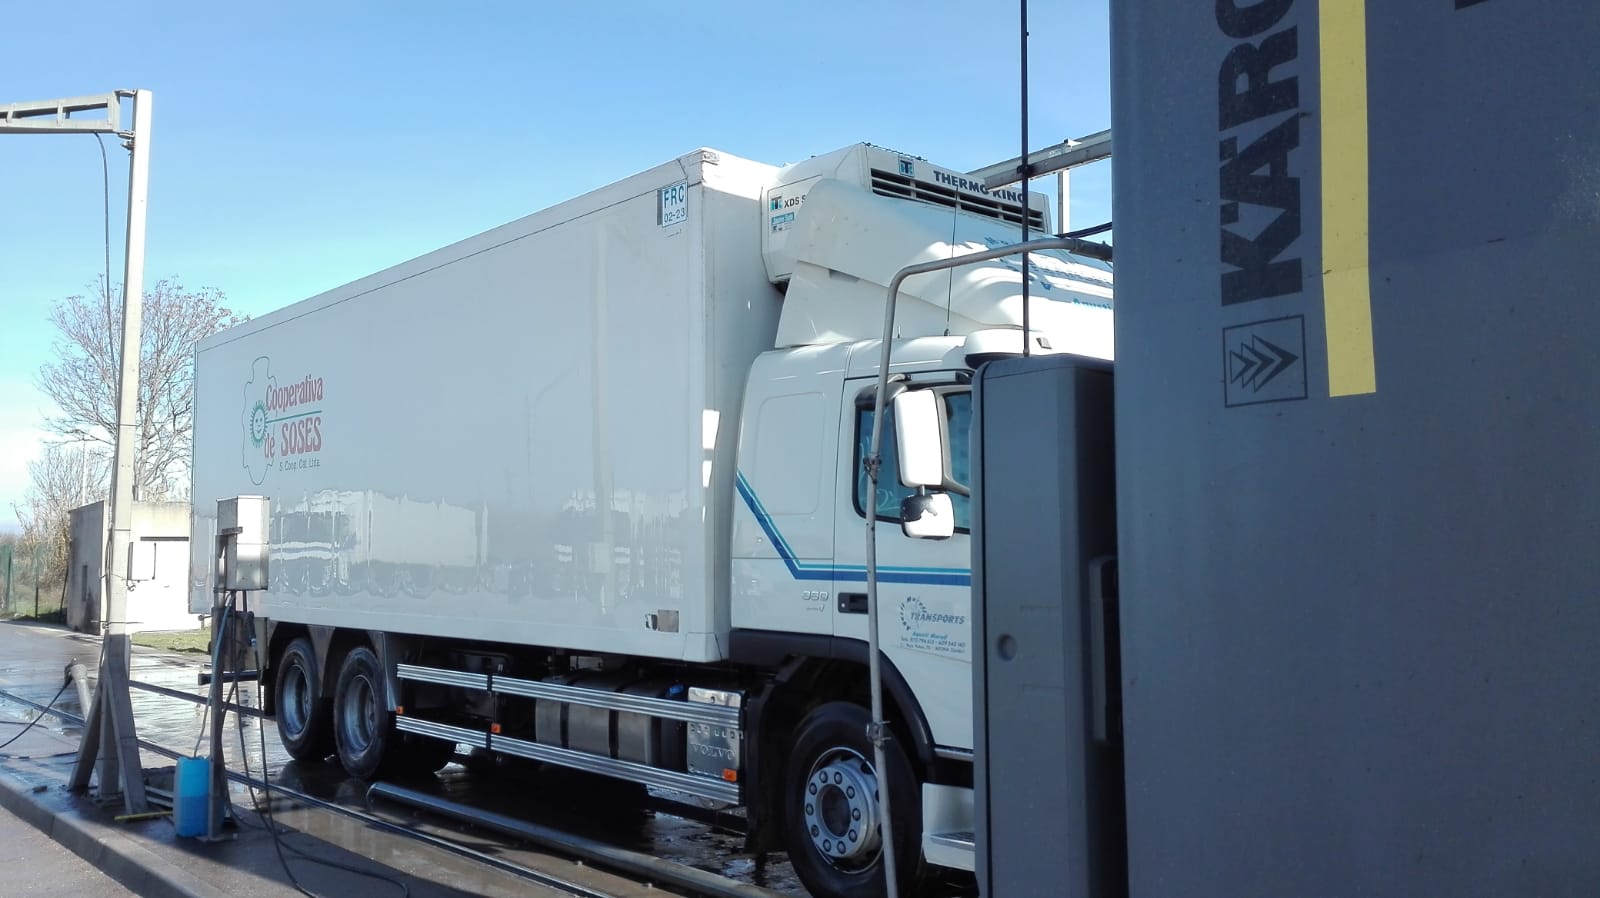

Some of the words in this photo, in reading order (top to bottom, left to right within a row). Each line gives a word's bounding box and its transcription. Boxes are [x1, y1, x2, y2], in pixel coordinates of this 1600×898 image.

[934, 171, 990, 195] THERMO
[664, 185, 685, 209] FRC
[784, 196, 800, 209] XDS
[664, 207, 685, 223] 02-23
[265, 373, 323, 413] Cooperativa
[264, 432, 275, 459] de
[280, 416, 322, 457] SOSES
[911, 612, 965, 625] TRANSPORTS
